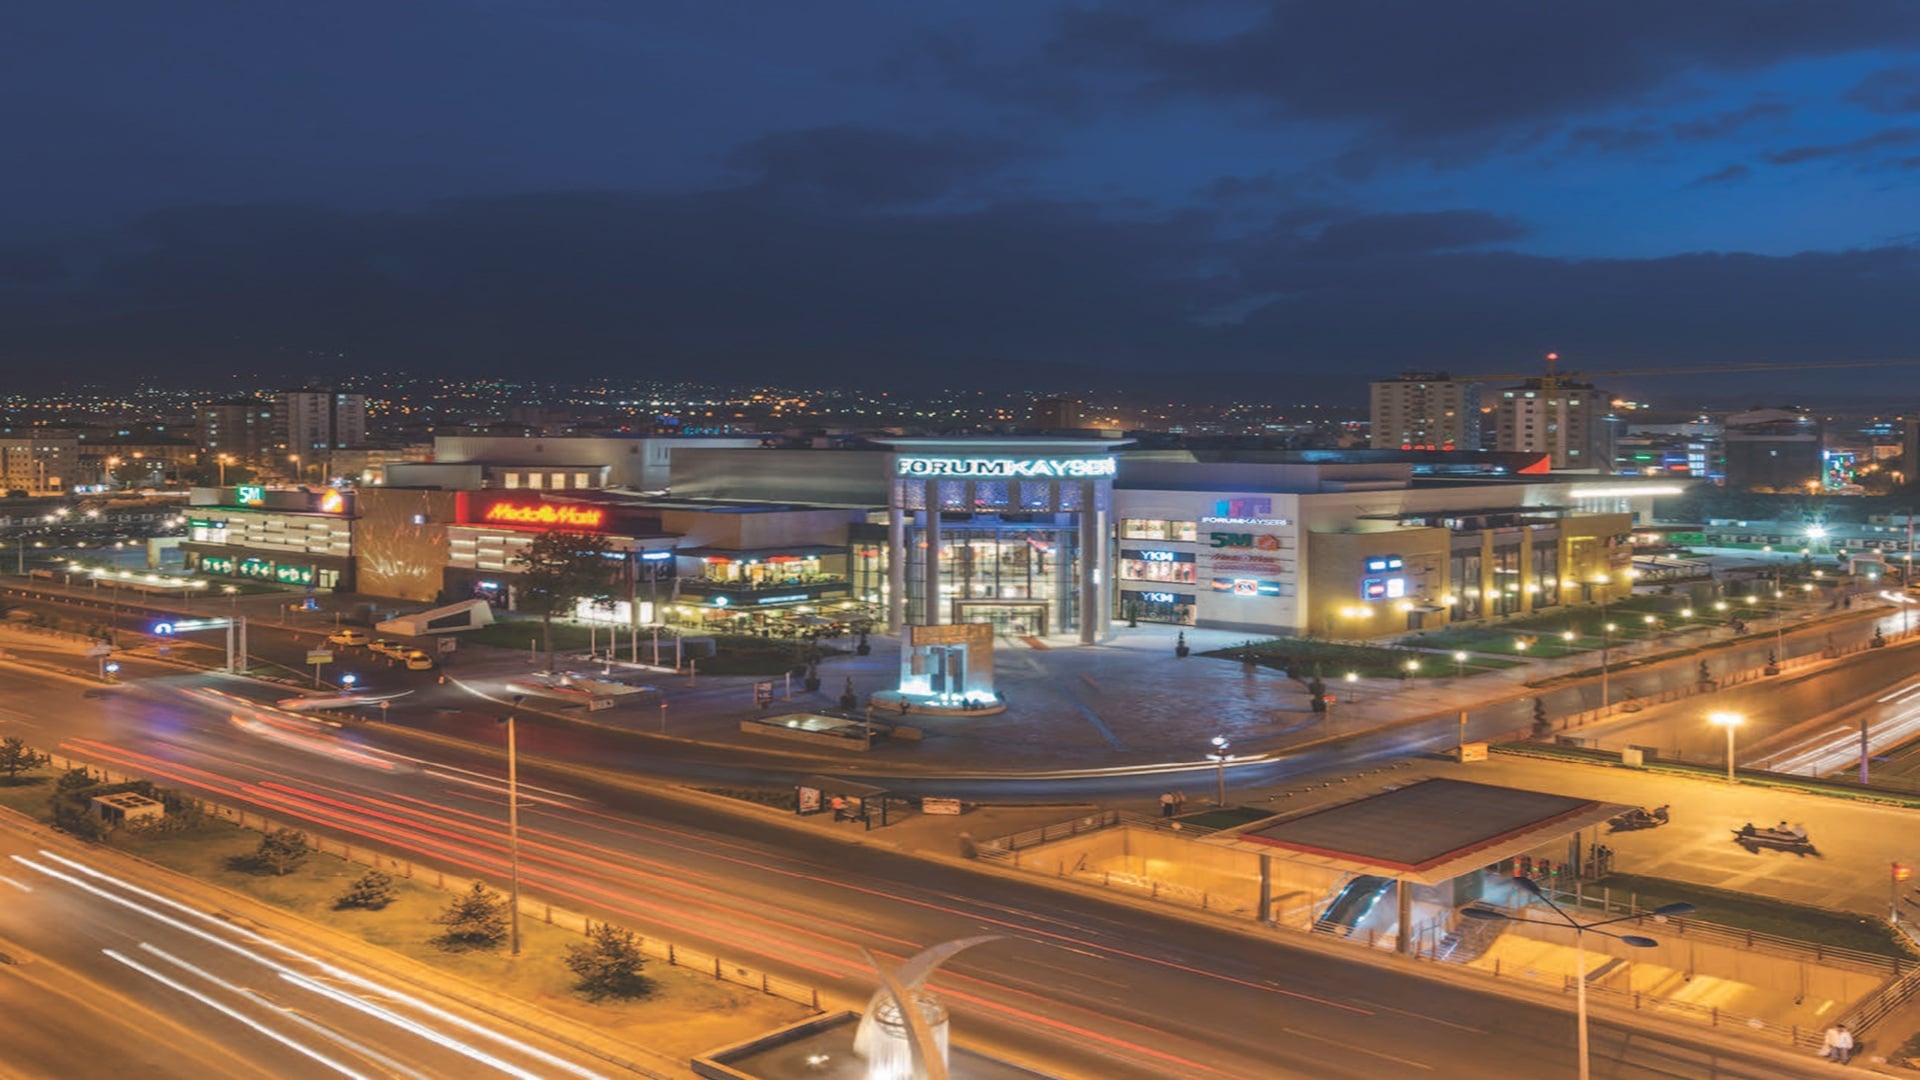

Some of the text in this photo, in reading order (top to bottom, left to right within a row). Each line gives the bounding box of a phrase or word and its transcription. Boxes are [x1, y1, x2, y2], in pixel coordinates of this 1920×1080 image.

[1210, 532, 1252, 548] 5M
[1141, 551, 1174, 562] YKM
[1141, 592, 1174, 603] YKM
